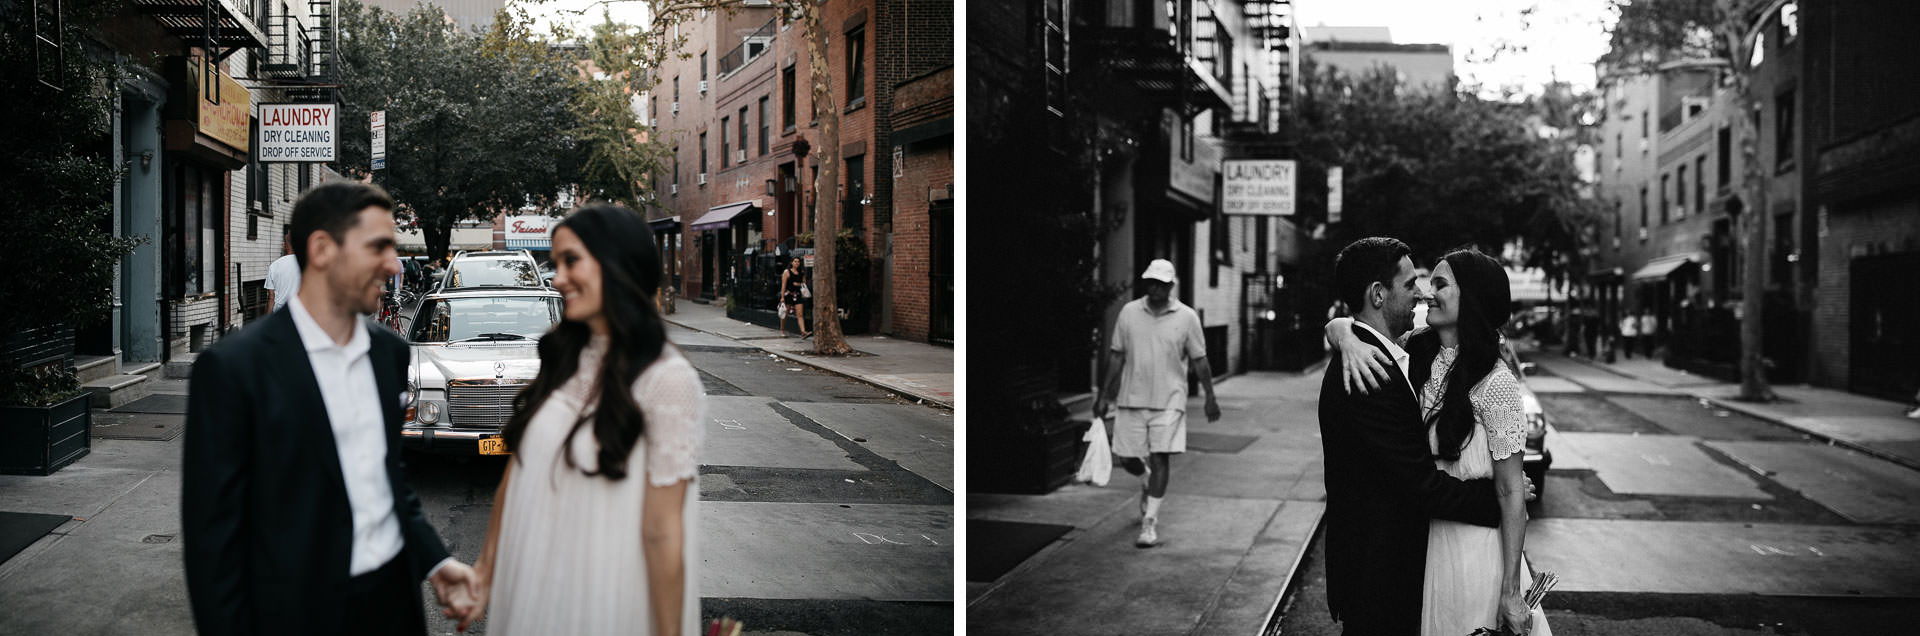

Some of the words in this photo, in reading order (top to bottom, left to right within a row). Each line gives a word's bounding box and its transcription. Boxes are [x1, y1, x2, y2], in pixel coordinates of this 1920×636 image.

[263, 108, 331, 126] LAUNDRY
[264, 130, 282, 143] DRY
[284, 130, 330, 143] CLEANING
[262, 147, 283, 158] DROP
[284, 147, 299, 158] OFF
[300, 147, 332, 158] SERVICE
[1226, 164, 1290, 181] LAUNDRY
